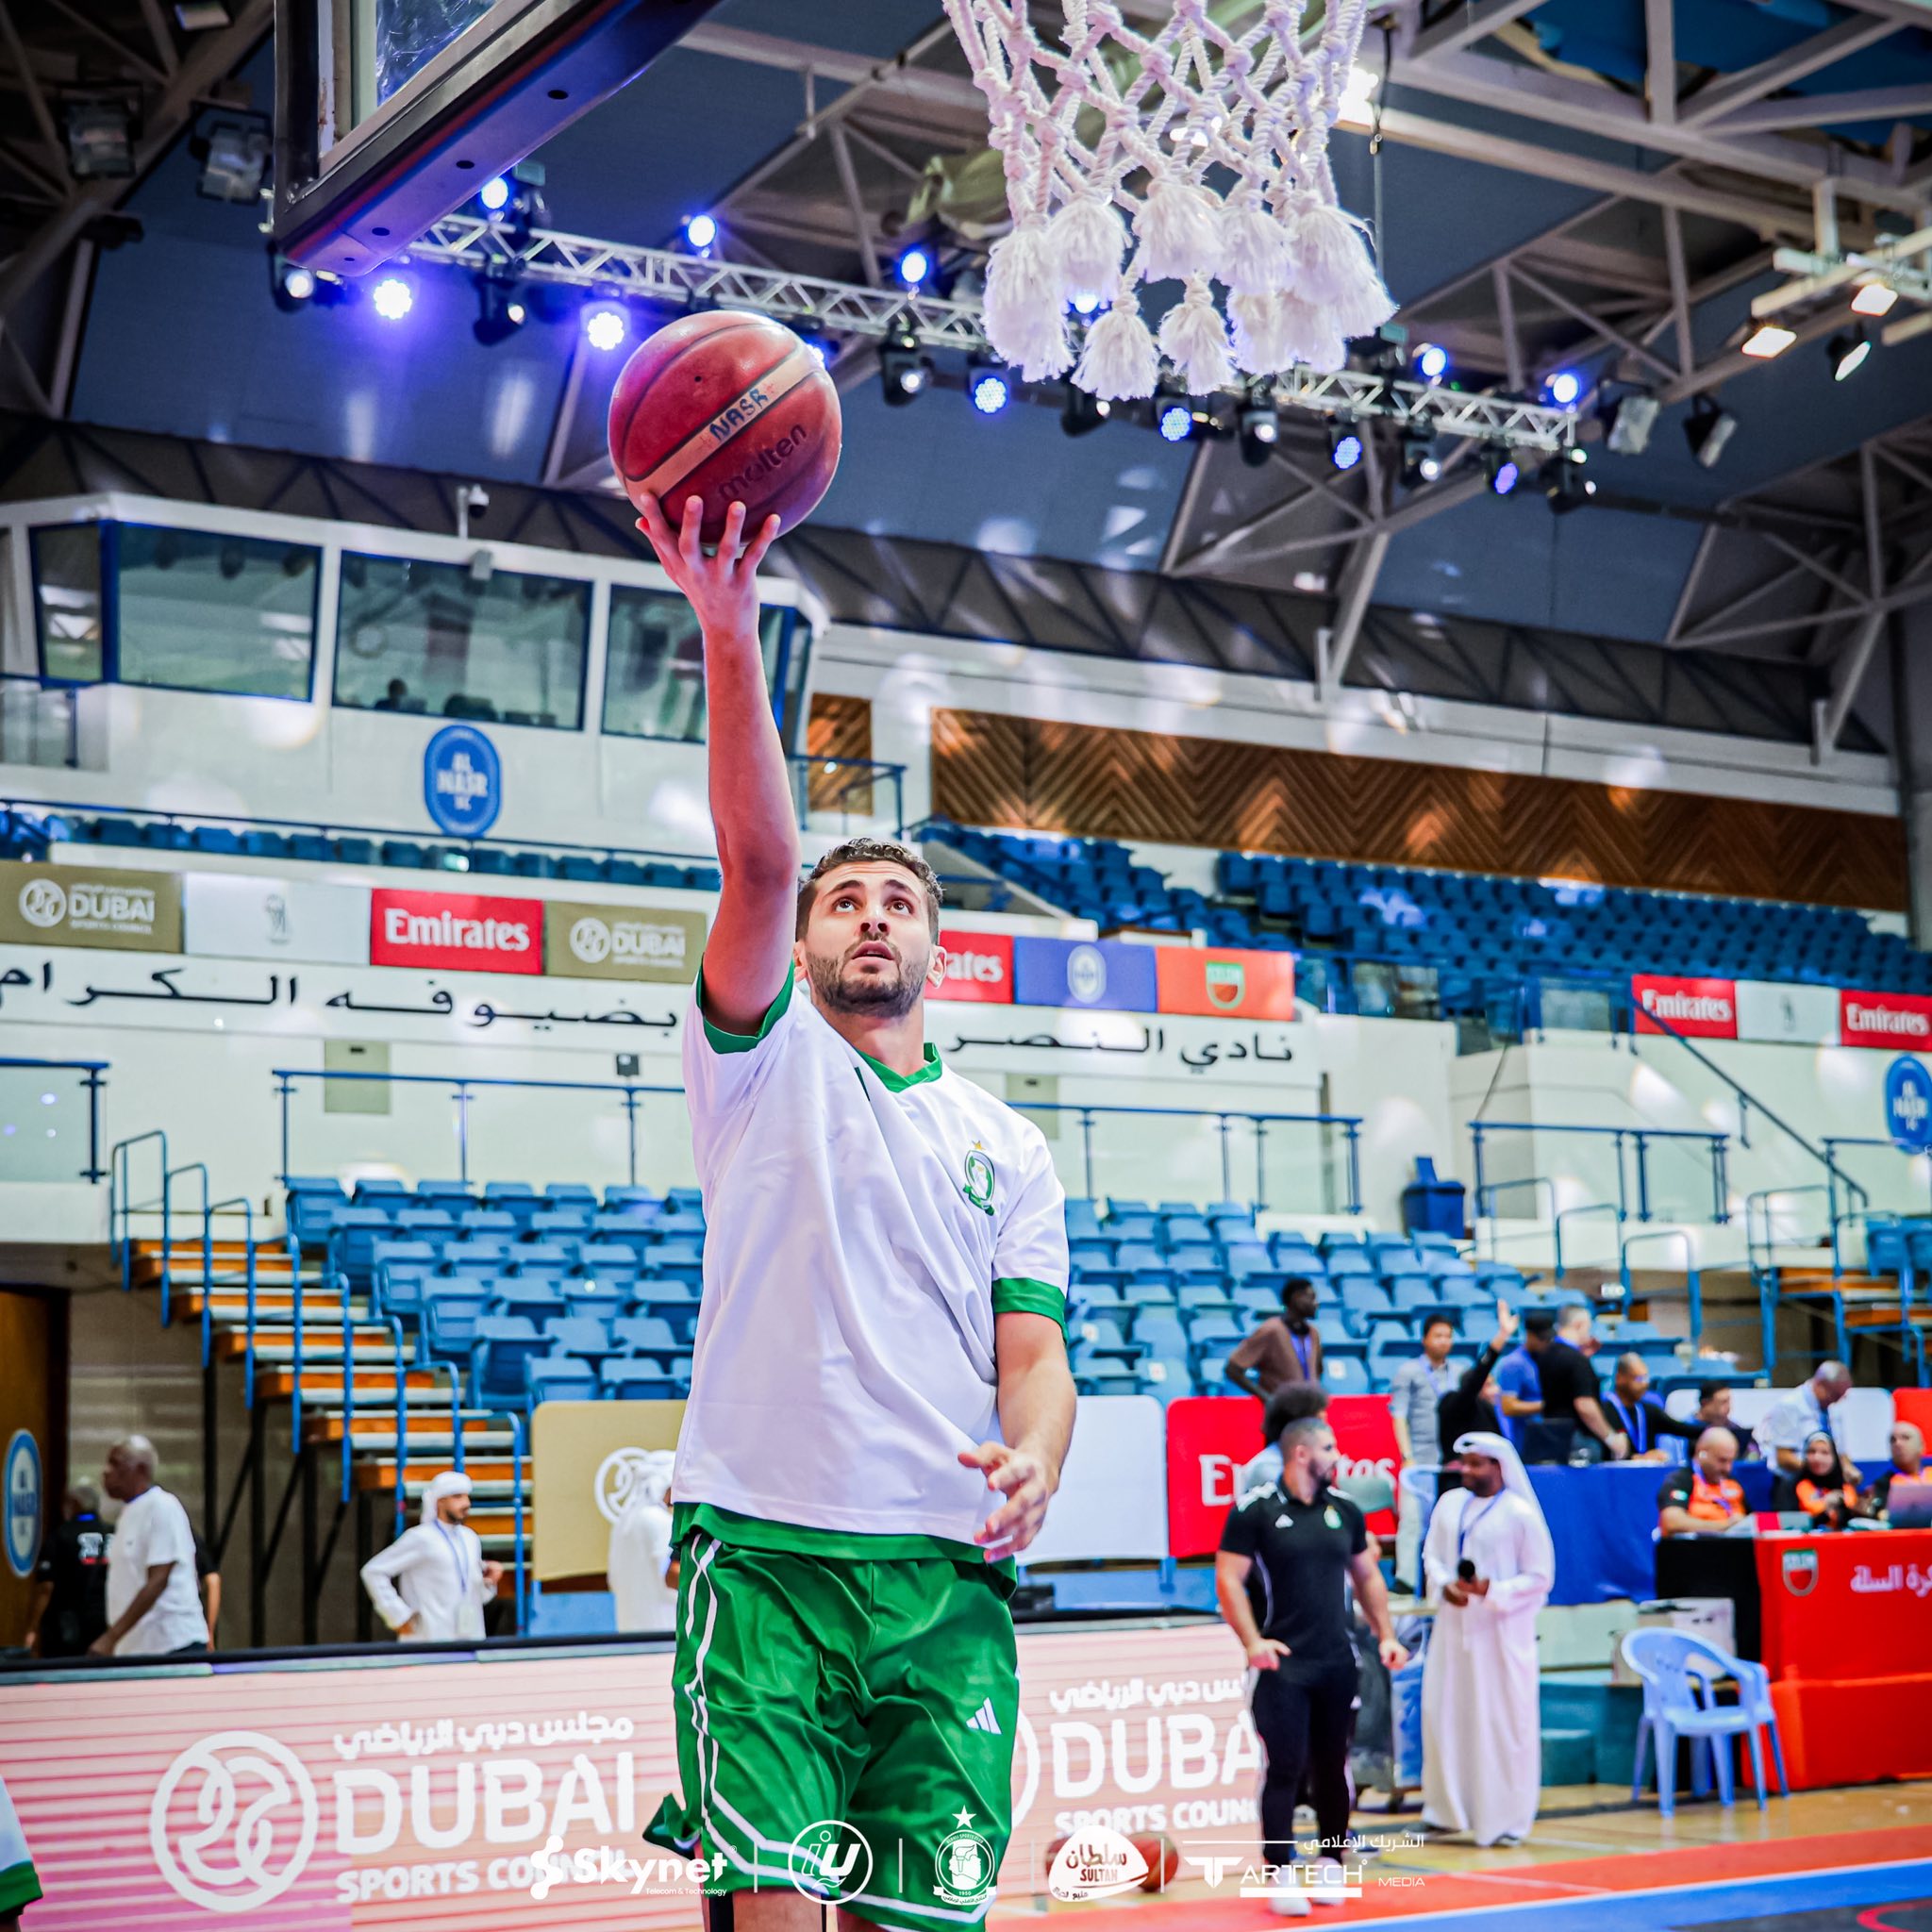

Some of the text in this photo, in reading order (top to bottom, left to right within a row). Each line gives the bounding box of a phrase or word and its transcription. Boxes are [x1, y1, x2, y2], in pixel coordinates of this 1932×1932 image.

[709, 389, 769, 441] NASR
[719, 424, 807, 501] molten
[69, 892, 155, 922] DUBAI
[384, 908, 530, 952] Emirates
[1641, 989, 1732, 1022] Emirates
[1846, 1003, 1929, 1036] Emirates
[946, 1028, 1291, 1074] نادي النصر
[1850, 1564, 1904, 1593] السلة
[333, 1711, 634, 1760] مجلس دبي الرياضي
[333, 1751, 635, 1855] DUBAI
[336, 1860, 479, 1904] SPORTS
